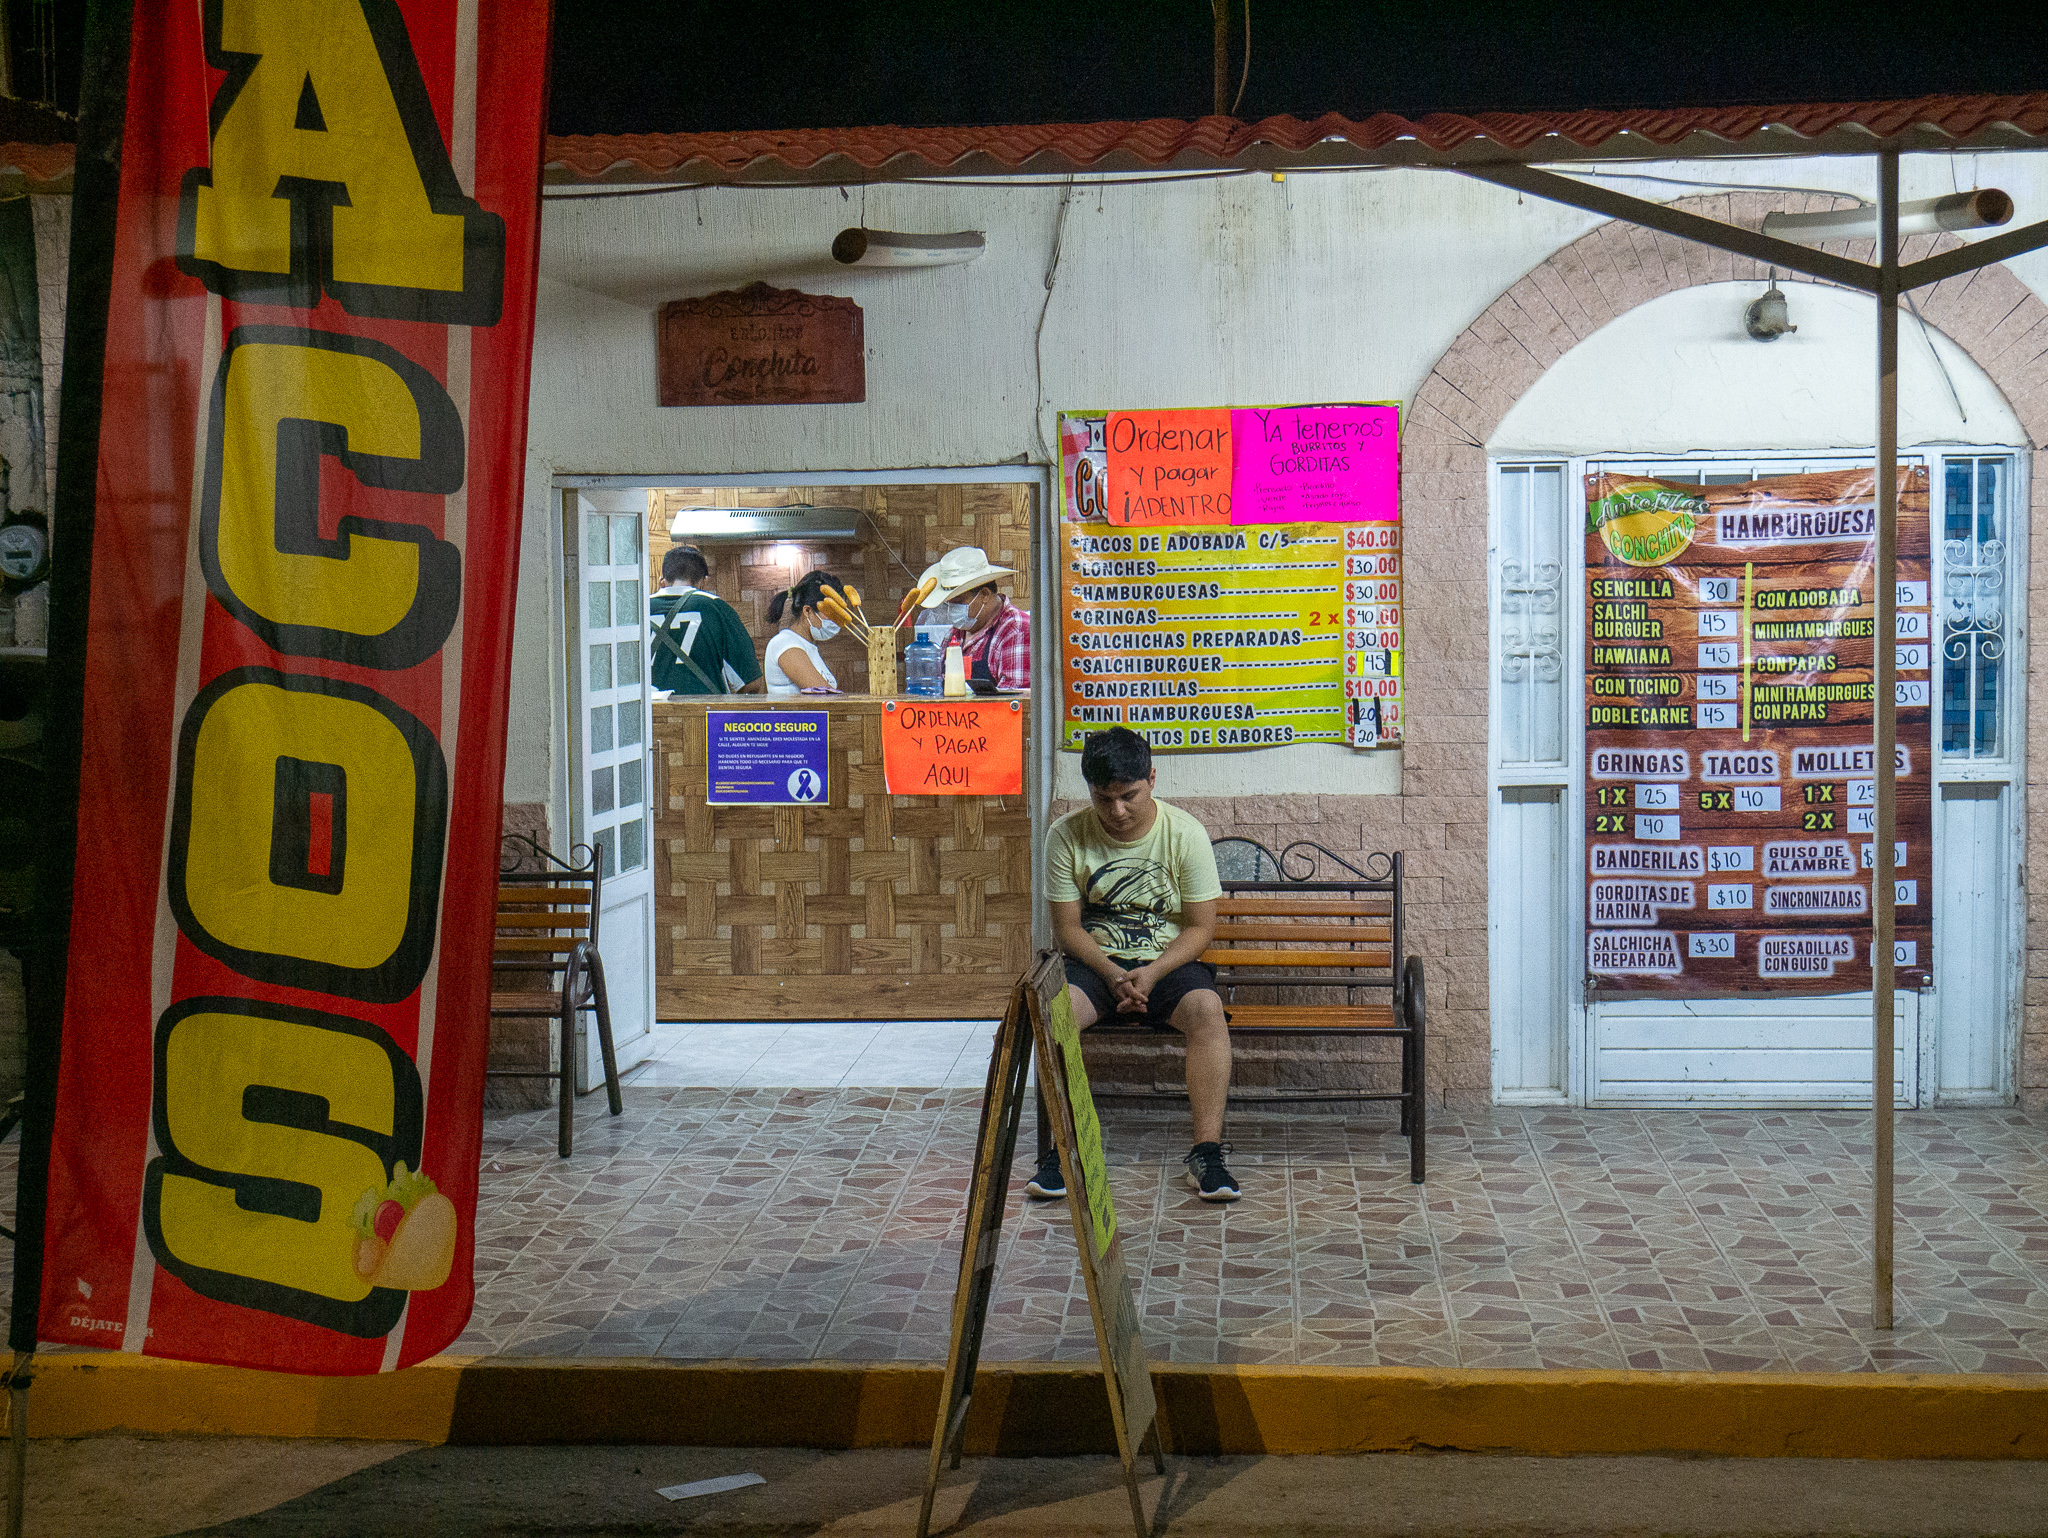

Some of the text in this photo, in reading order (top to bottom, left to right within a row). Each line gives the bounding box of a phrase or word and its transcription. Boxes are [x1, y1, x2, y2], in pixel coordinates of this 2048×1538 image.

[702, 345, 818, 388] Conchita
[1113, 418, 1228, 453] Ordenar
[1292, 442, 1347, 455] BURRITOS
[1270, 454, 1350, 476] GORDITAS
[1155, 466, 1218, 490] pagar
[1722, 509, 1875, 538] HAMBURGUESA
[1081, 537, 1132, 552] TACOS
[1140, 537, 1160, 551] DE
[1166, 535, 1246, 551] ADOBADA
[1347, 530, 1397, 549] $40.00
[1610, 513, 1695, 560] CONCHITA
[1082, 561, 1156, 577] LONCHES
[1083, 583, 1219, 601] HAMBURGUESAS
[1593, 580, 1672, 597] SENCILLA
[1706, 581, 1728, 600] 30
[1757, 589, 1859, 608] CON ADOBADA
[1083, 609, 1157, 626] GRINGAS
[1594, 604, 1646, 620] SALCHI
[1594, 621, 1661, 638] BURGUER
[1703, 614, 1726, 632] 45
[1755, 620, 1875, 639] MINI HAMBURGUES
[1896, 616, 1918, 633] 20
[1081, 633, 1185, 649] SALCHICHAS
[1193, 630, 1301, 648] PREPARADAS
[1594, 648, 1670, 664] HAWAIANA
[1705, 647, 1730, 663] 45
[1757, 655, 1836, 672] CON PAPAS
[1083, 656, 1222, 673] SALCHIBURGUER
[1084, 679, 1397, 698] BANDERILLAS $10.00
[1595, 678, 1680, 695] CON TOCINO
[1703, 679, 1726, 695] 45
[1754, 684, 1875, 702] MINI HAMBURGUES
[1895, 684, 1921, 703] 30
[901, 707, 981, 730] ORDENAR
[1082, 707, 1122, 722] MINI
[1129, 705, 1254, 721] HAMBURGUESA
[1592, 707, 1689, 724] DOBLE CARNE
[1704, 707, 1725, 723] 45
[1754, 703, 1826, 719] CON PAPAS
[724, 722, 817, 732] NEGOCIO SEGURO
[1191, 730, 1211, 744] DE
[1218, 727, 1293, 743] SABORES
[935, 734, 989, 754] PAGAR
[1597, 754, 1684, 773] GRINGAS
[1707, 756, 1774, 775] TACOS
[1798, 751, 1904, 772] MOLLETS
[923, 763, 970, 787] AQUI
[1644, 788, 1667, 805] 25
[1741, 790, 1763, 807] 40
[1643, 818, 1664, 834] 40
[1596, 850, 1699, 869] BANDERILAS
[1711, 851, 1741, 871] $10
[1769, 846, 1844, 859] GUISO DE
[1769, 858, 1850, 872] ALAMBRE
[1596, 885, 1689, 902] GORDITAS DE
[1716, 889, 1746, 906] $10
[1770, 891, 1862, 908] SINCRONIZADAS
[1596, 903, 1652, 918] HARINA
[1593, 936, 1672, 951] SALCHICHA
[1695, 938, 1730, 954] $30
[1765, 941, 1849, 955] QUESADILLAS
[1593, 953, 1677, 967] PREPARADA
[1765, 957, 1828, 971] CON GUISO
[70, 1315, 123, 1332] DÉJATE
